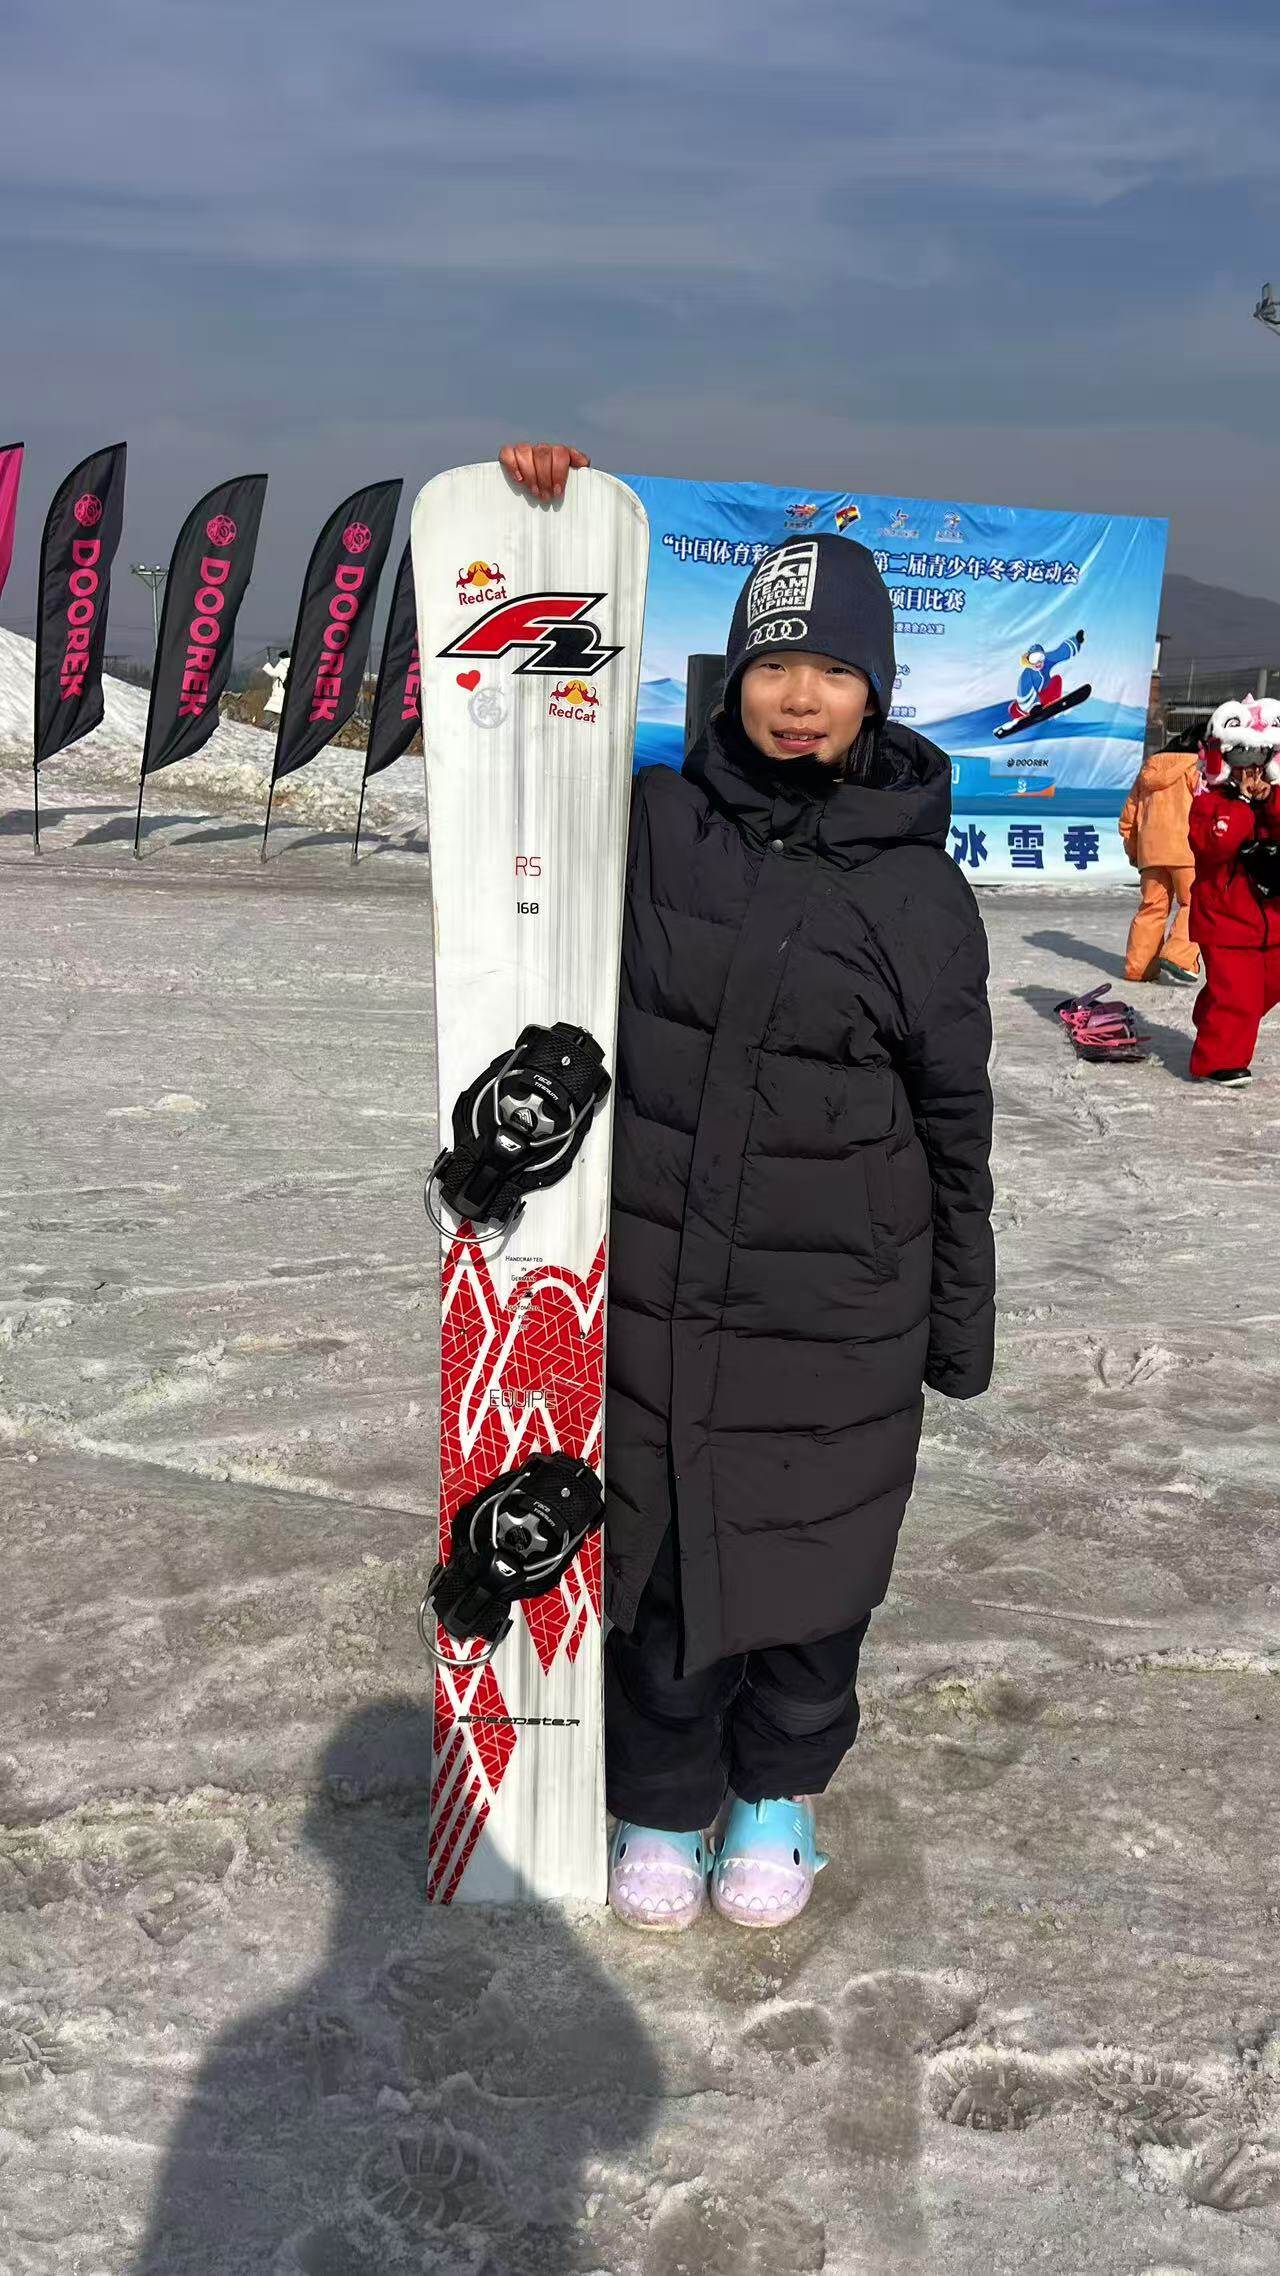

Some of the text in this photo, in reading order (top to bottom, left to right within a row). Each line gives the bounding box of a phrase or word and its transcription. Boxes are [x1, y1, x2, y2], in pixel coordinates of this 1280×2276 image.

[873, 550, 1080, 584] 第二届青少年冬季运动会
[751, 587, 807, 611] SWEDEN
[752, 577, 808, 602] TEAM
[888, 587, 965, 612] 项目比赛
[751, 596, 806, 619] ALPINE
[60, 540, 101, 701] DOOREK
[178, 557, 231, 718] DOOREK
[309, 564, 366, 722] DOOREK
[435, 592, 626, 676] F2
[950, 823, 1100, 870] 冰雪季
[515, 856, 542, 877] RS
[516, 902, 539, 914] 160
[489, 1389, 556, 1408] EQUIPE
